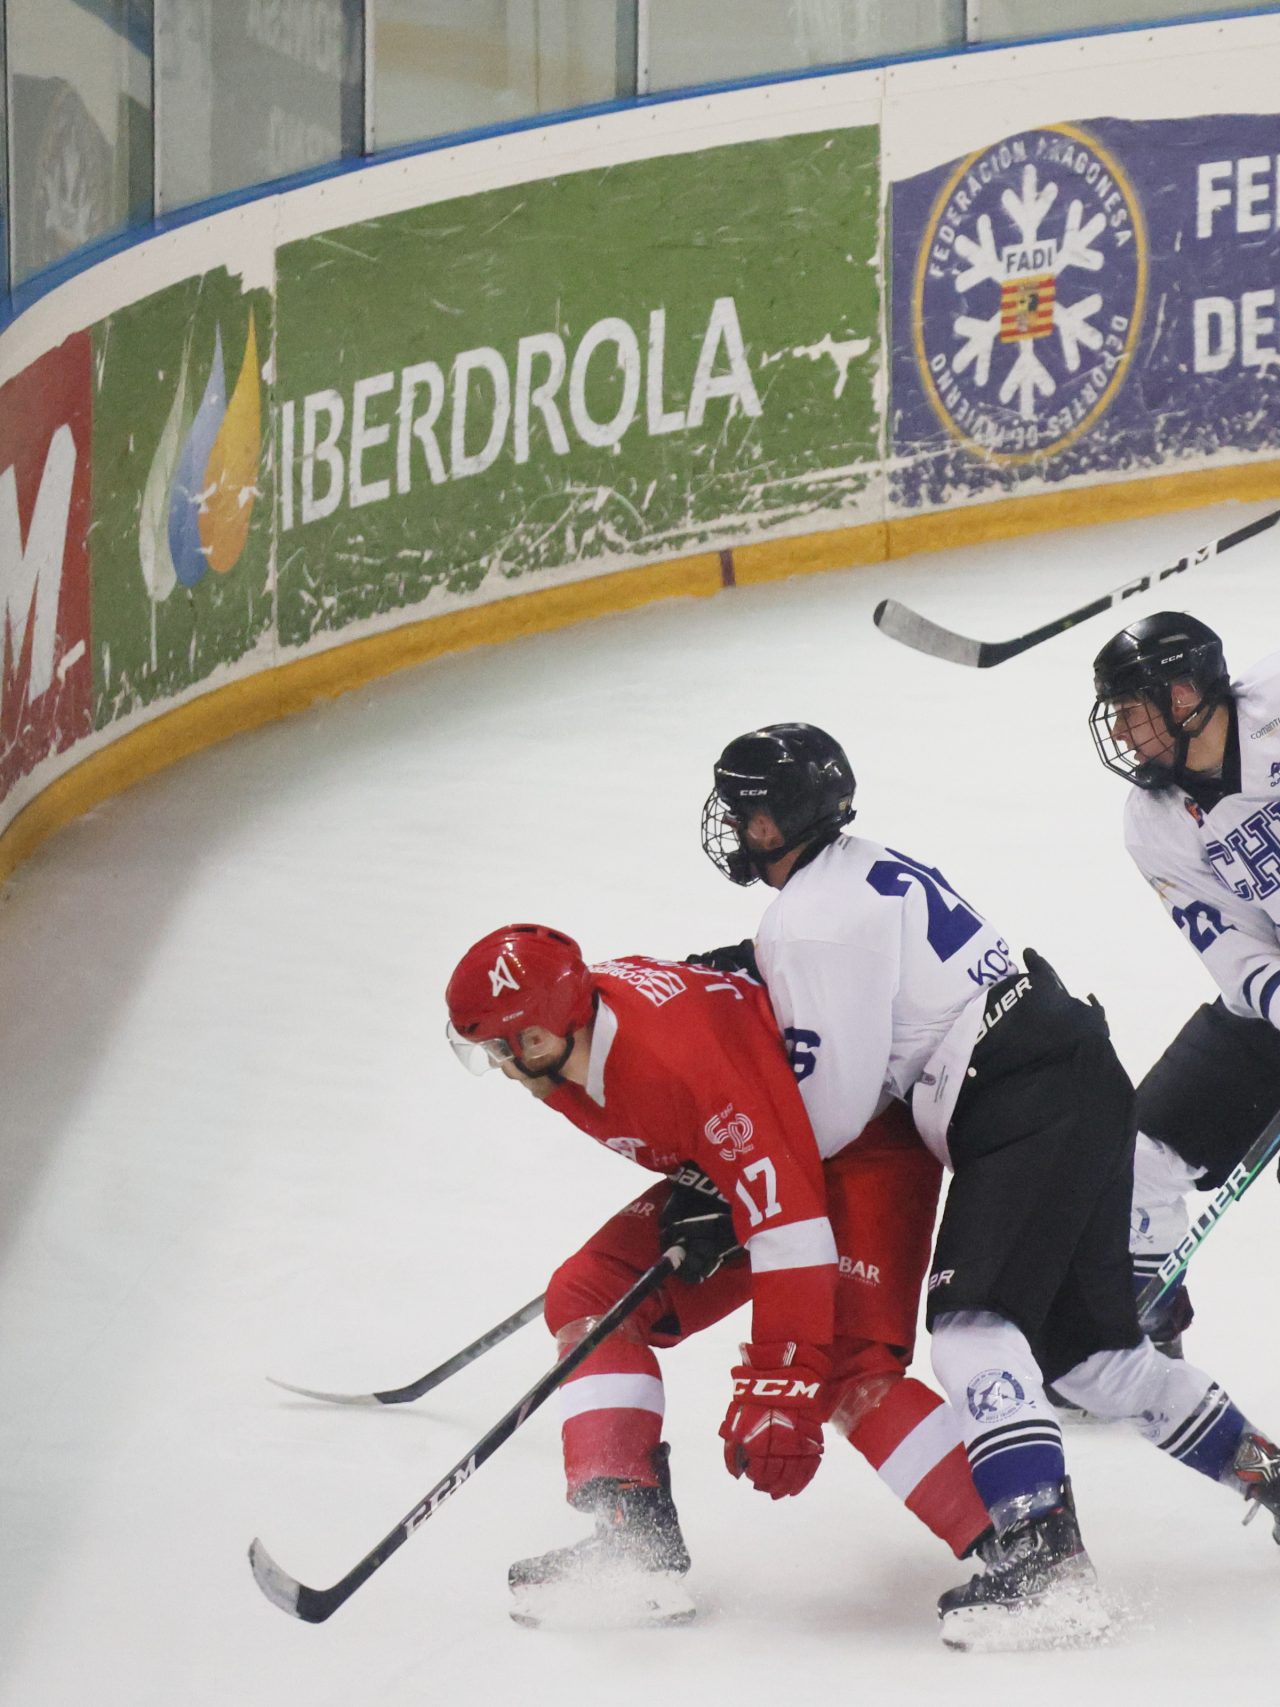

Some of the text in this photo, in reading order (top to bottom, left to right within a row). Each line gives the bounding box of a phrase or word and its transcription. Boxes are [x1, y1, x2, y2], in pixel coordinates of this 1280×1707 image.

[1005, 247, 1053, 274] FADI
[282, 296, 763, 532] IBERDROLA
[1161, 653, 1183, 664] CCM
[1172, 899, 1239, 954] 22
[735, 1156, 783, 1227] 17
[1158, 1161, 1251, 1285] BAUER
[838, 1255, 881, 1285] BAR
[733, 1378, 820, 1399] CCM
